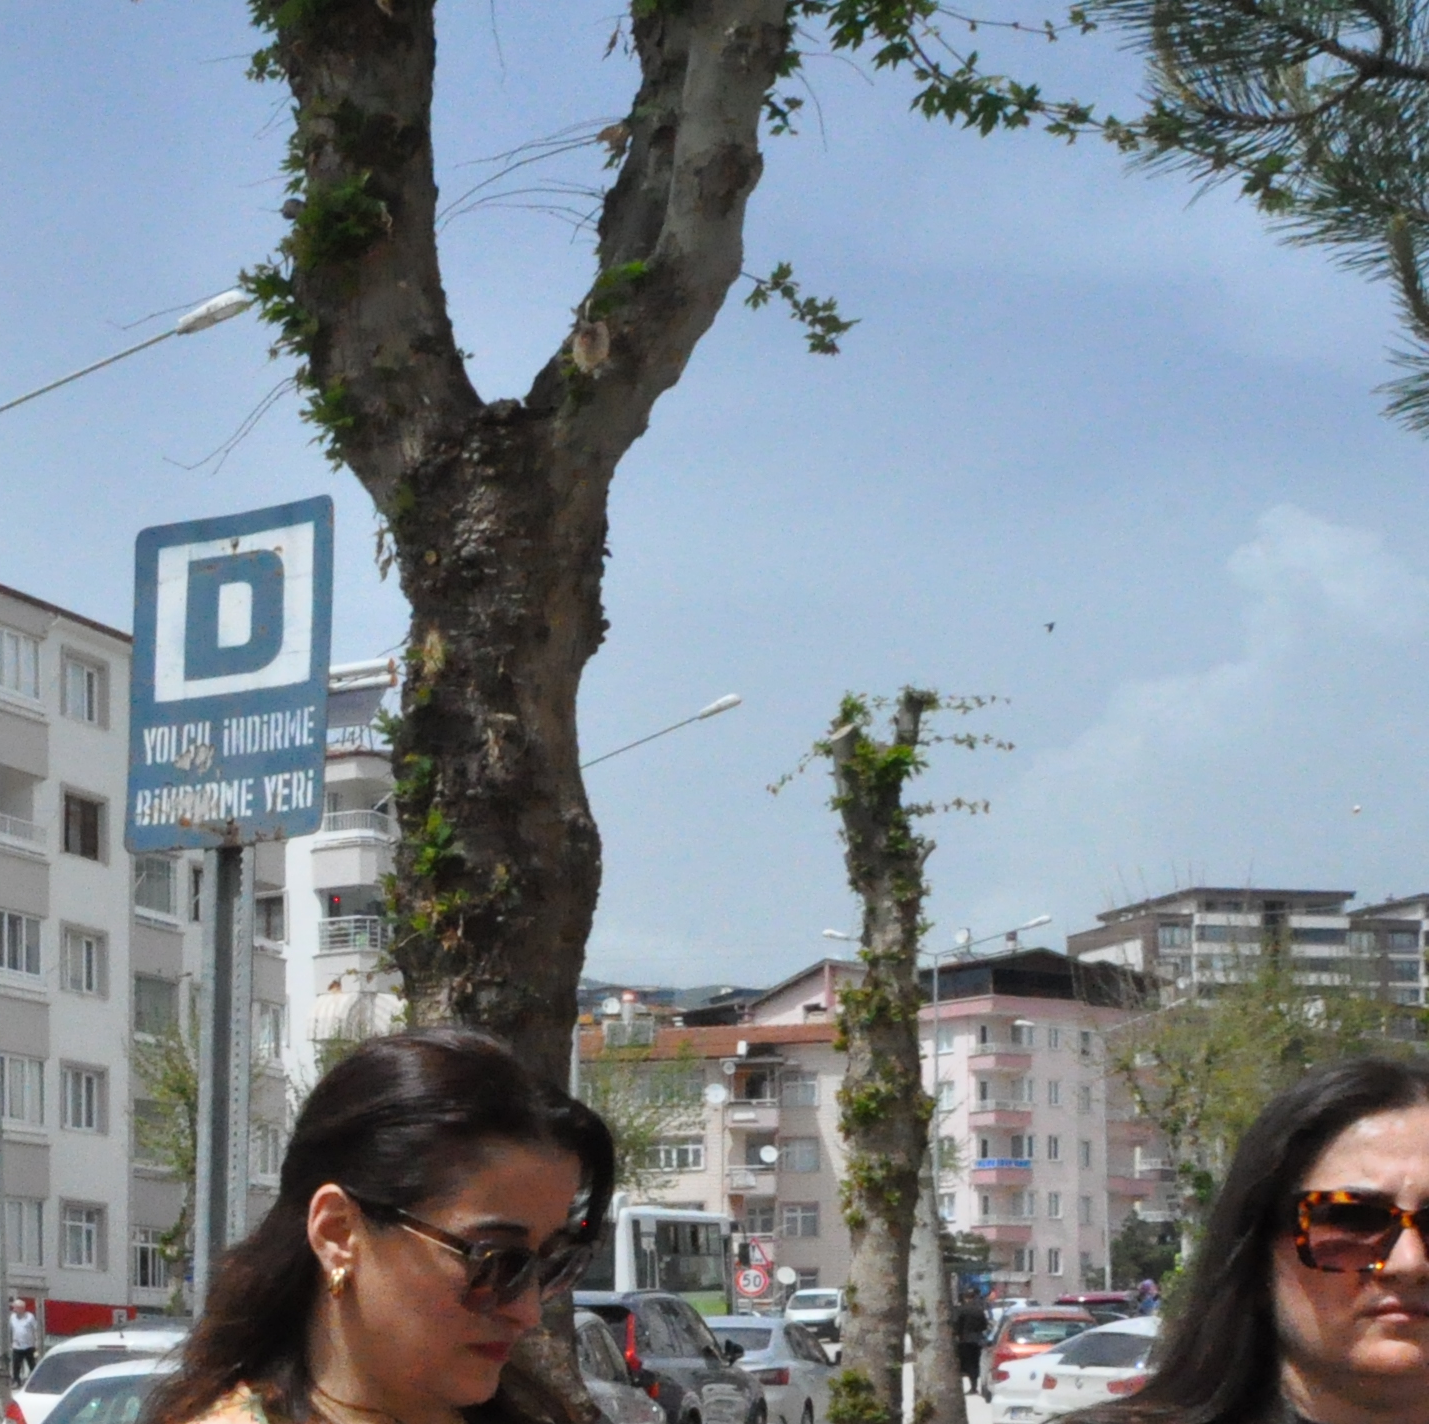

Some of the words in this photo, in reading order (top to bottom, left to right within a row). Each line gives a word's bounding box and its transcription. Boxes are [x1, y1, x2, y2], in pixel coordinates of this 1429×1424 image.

[184, 549, 284, 682] D
[143, 721, 212, 766] YOLCU
[742, 1273, 762, 1289] 50
